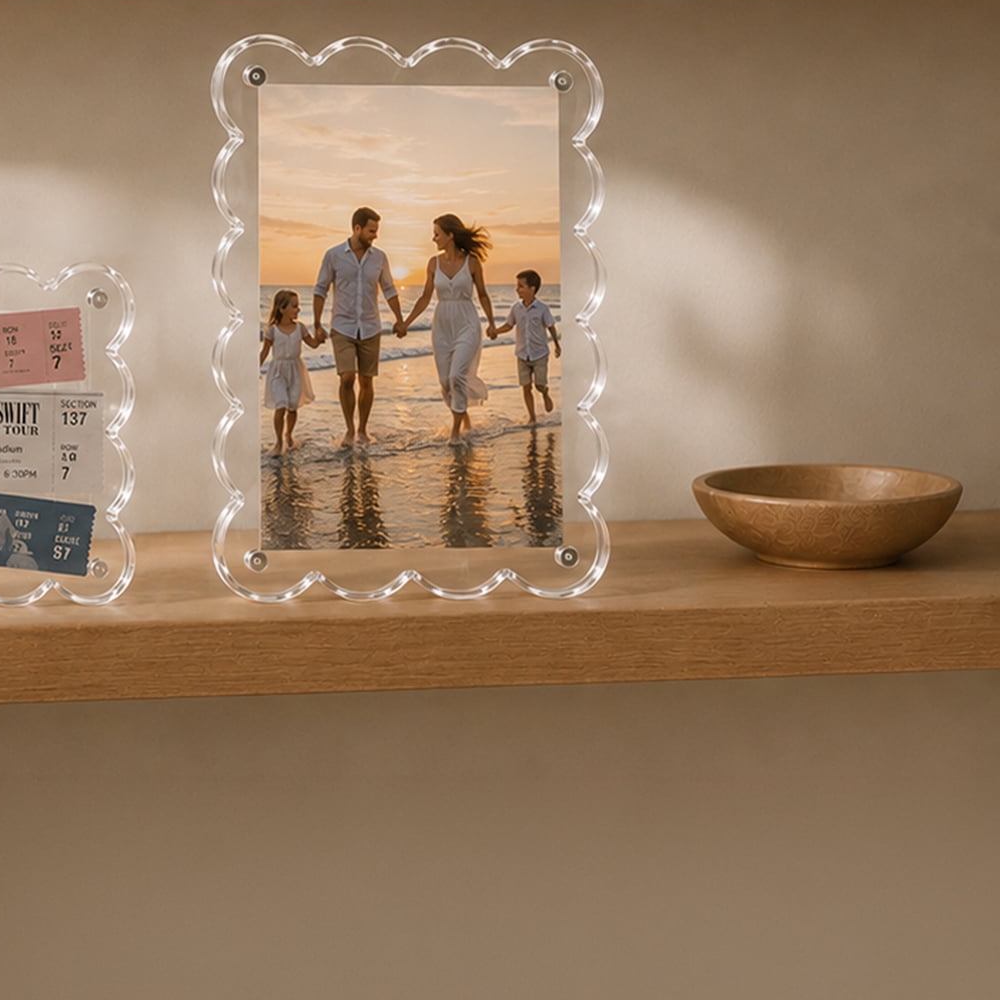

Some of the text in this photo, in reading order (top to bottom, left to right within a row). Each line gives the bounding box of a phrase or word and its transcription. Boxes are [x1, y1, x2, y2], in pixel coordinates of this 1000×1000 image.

[61, 411, 88, 426] 137
[3, 425, 40, 437] TOUR
[61, 466, 70, 481] 7
